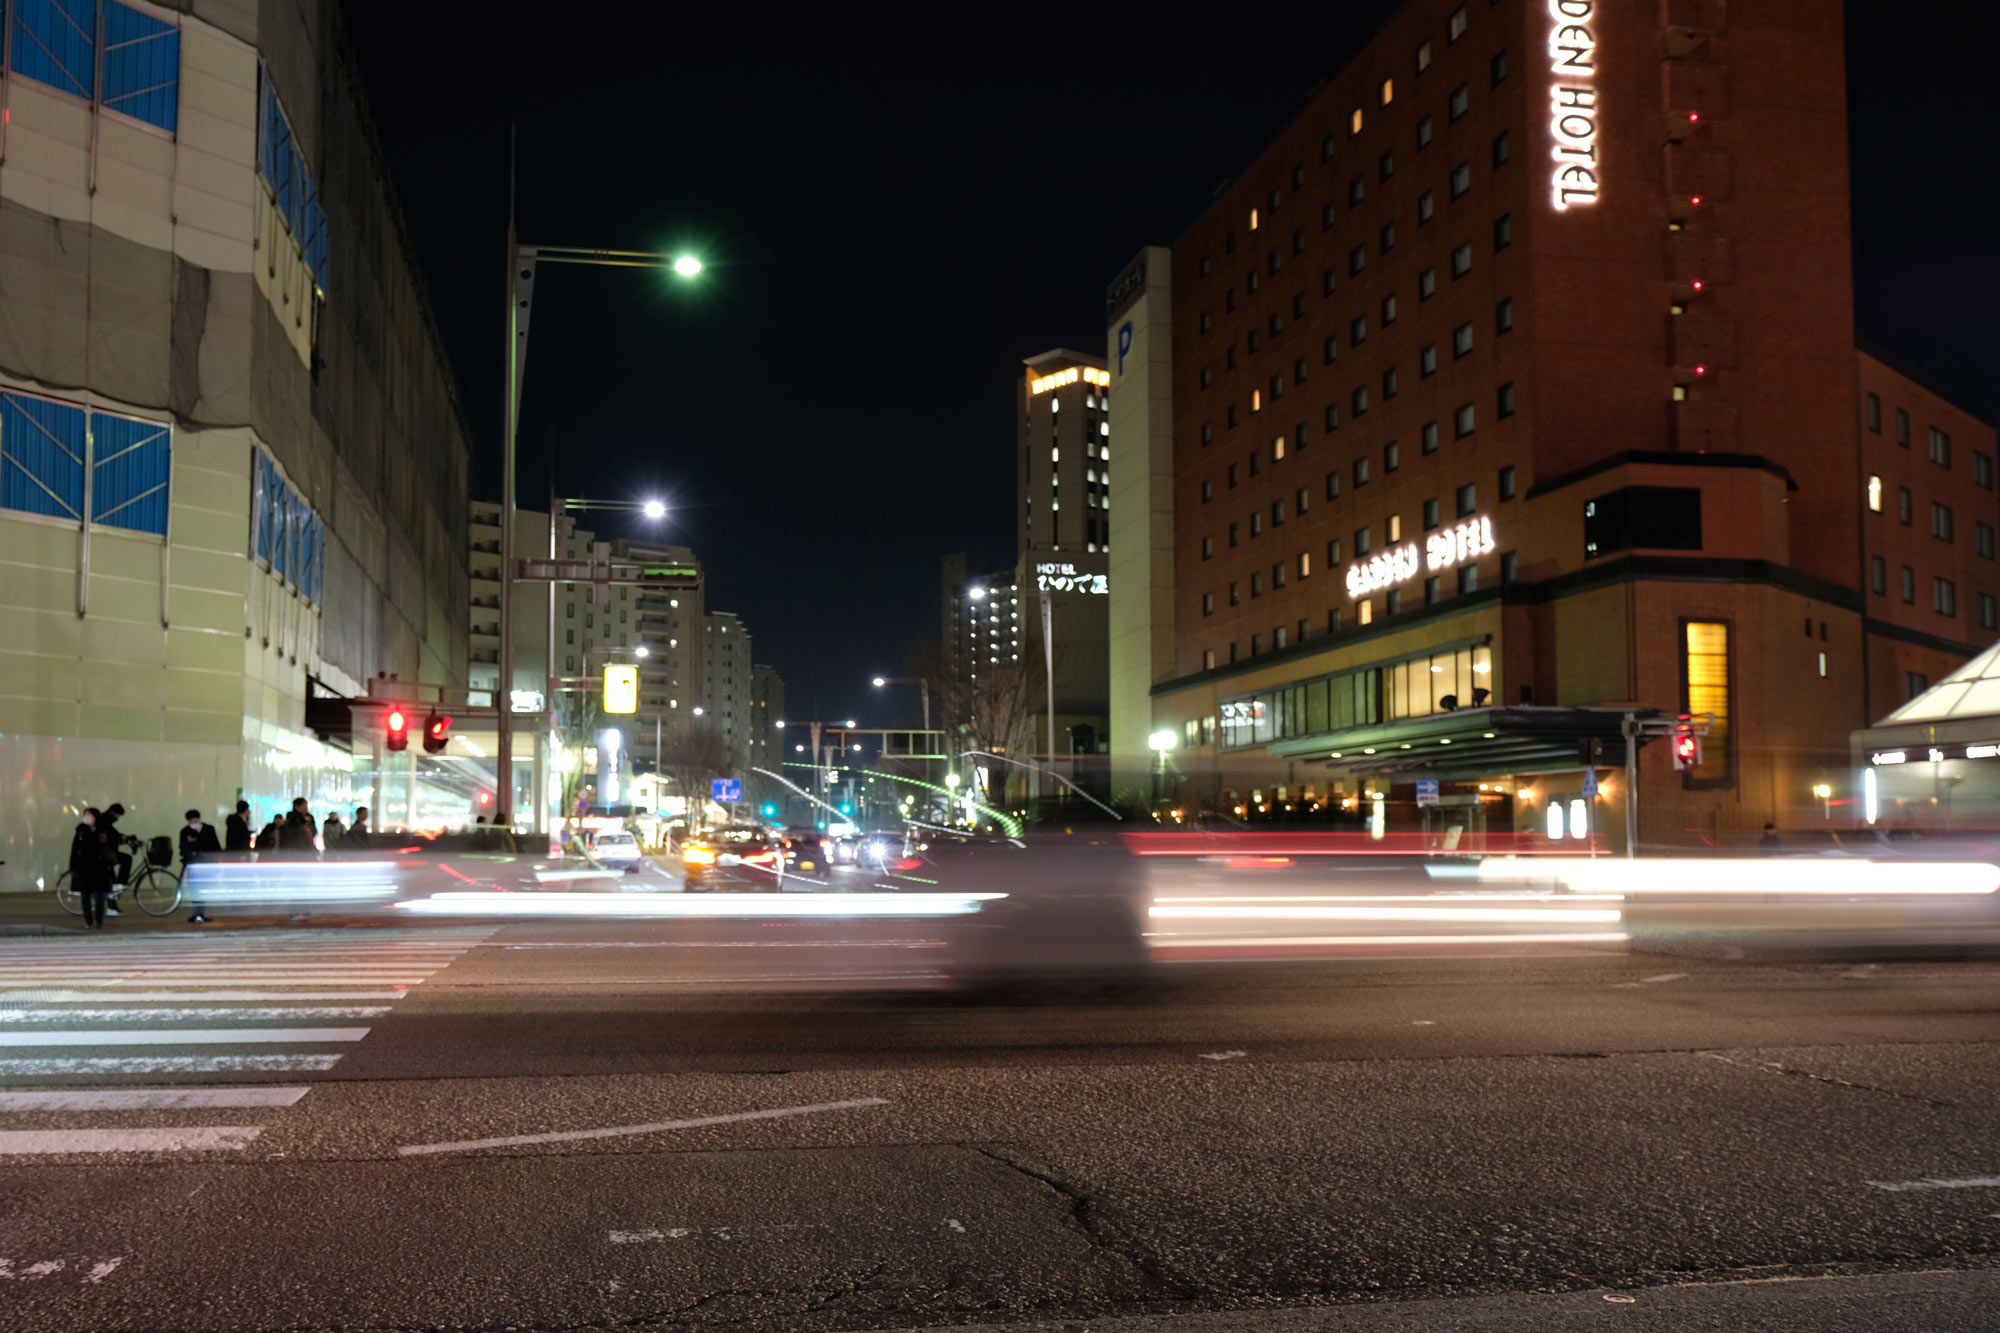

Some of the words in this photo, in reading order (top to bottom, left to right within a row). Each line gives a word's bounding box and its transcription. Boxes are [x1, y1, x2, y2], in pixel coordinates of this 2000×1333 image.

[1551, 85, 1598, 211] HOTEL
[1118, 321, 1132, 376] P
[1037, 563, 1077, 575] HOTEL
